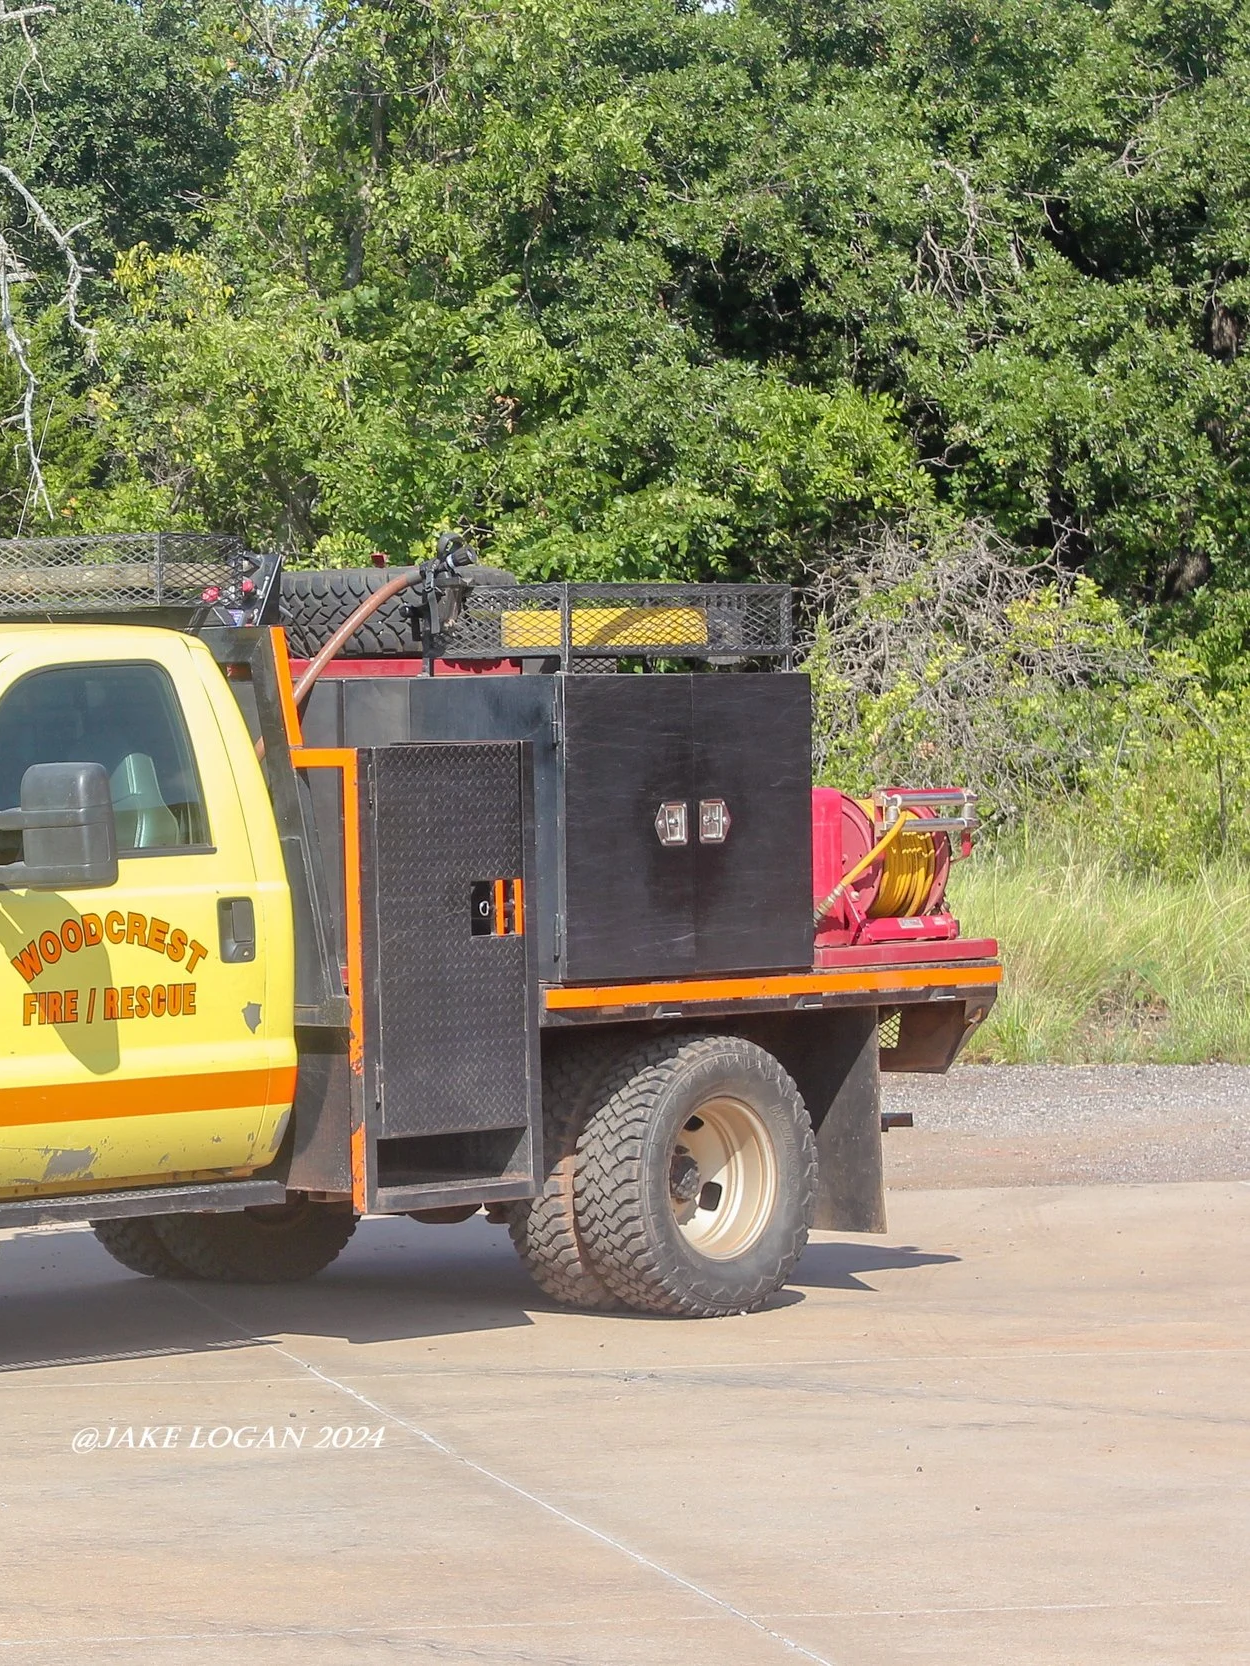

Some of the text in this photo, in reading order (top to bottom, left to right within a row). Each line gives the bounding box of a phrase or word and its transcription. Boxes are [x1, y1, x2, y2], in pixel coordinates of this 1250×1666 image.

[10, 910, 209, 983] WOODCREST
[23, 983, 196, 1026] FIRE / RESCUE
